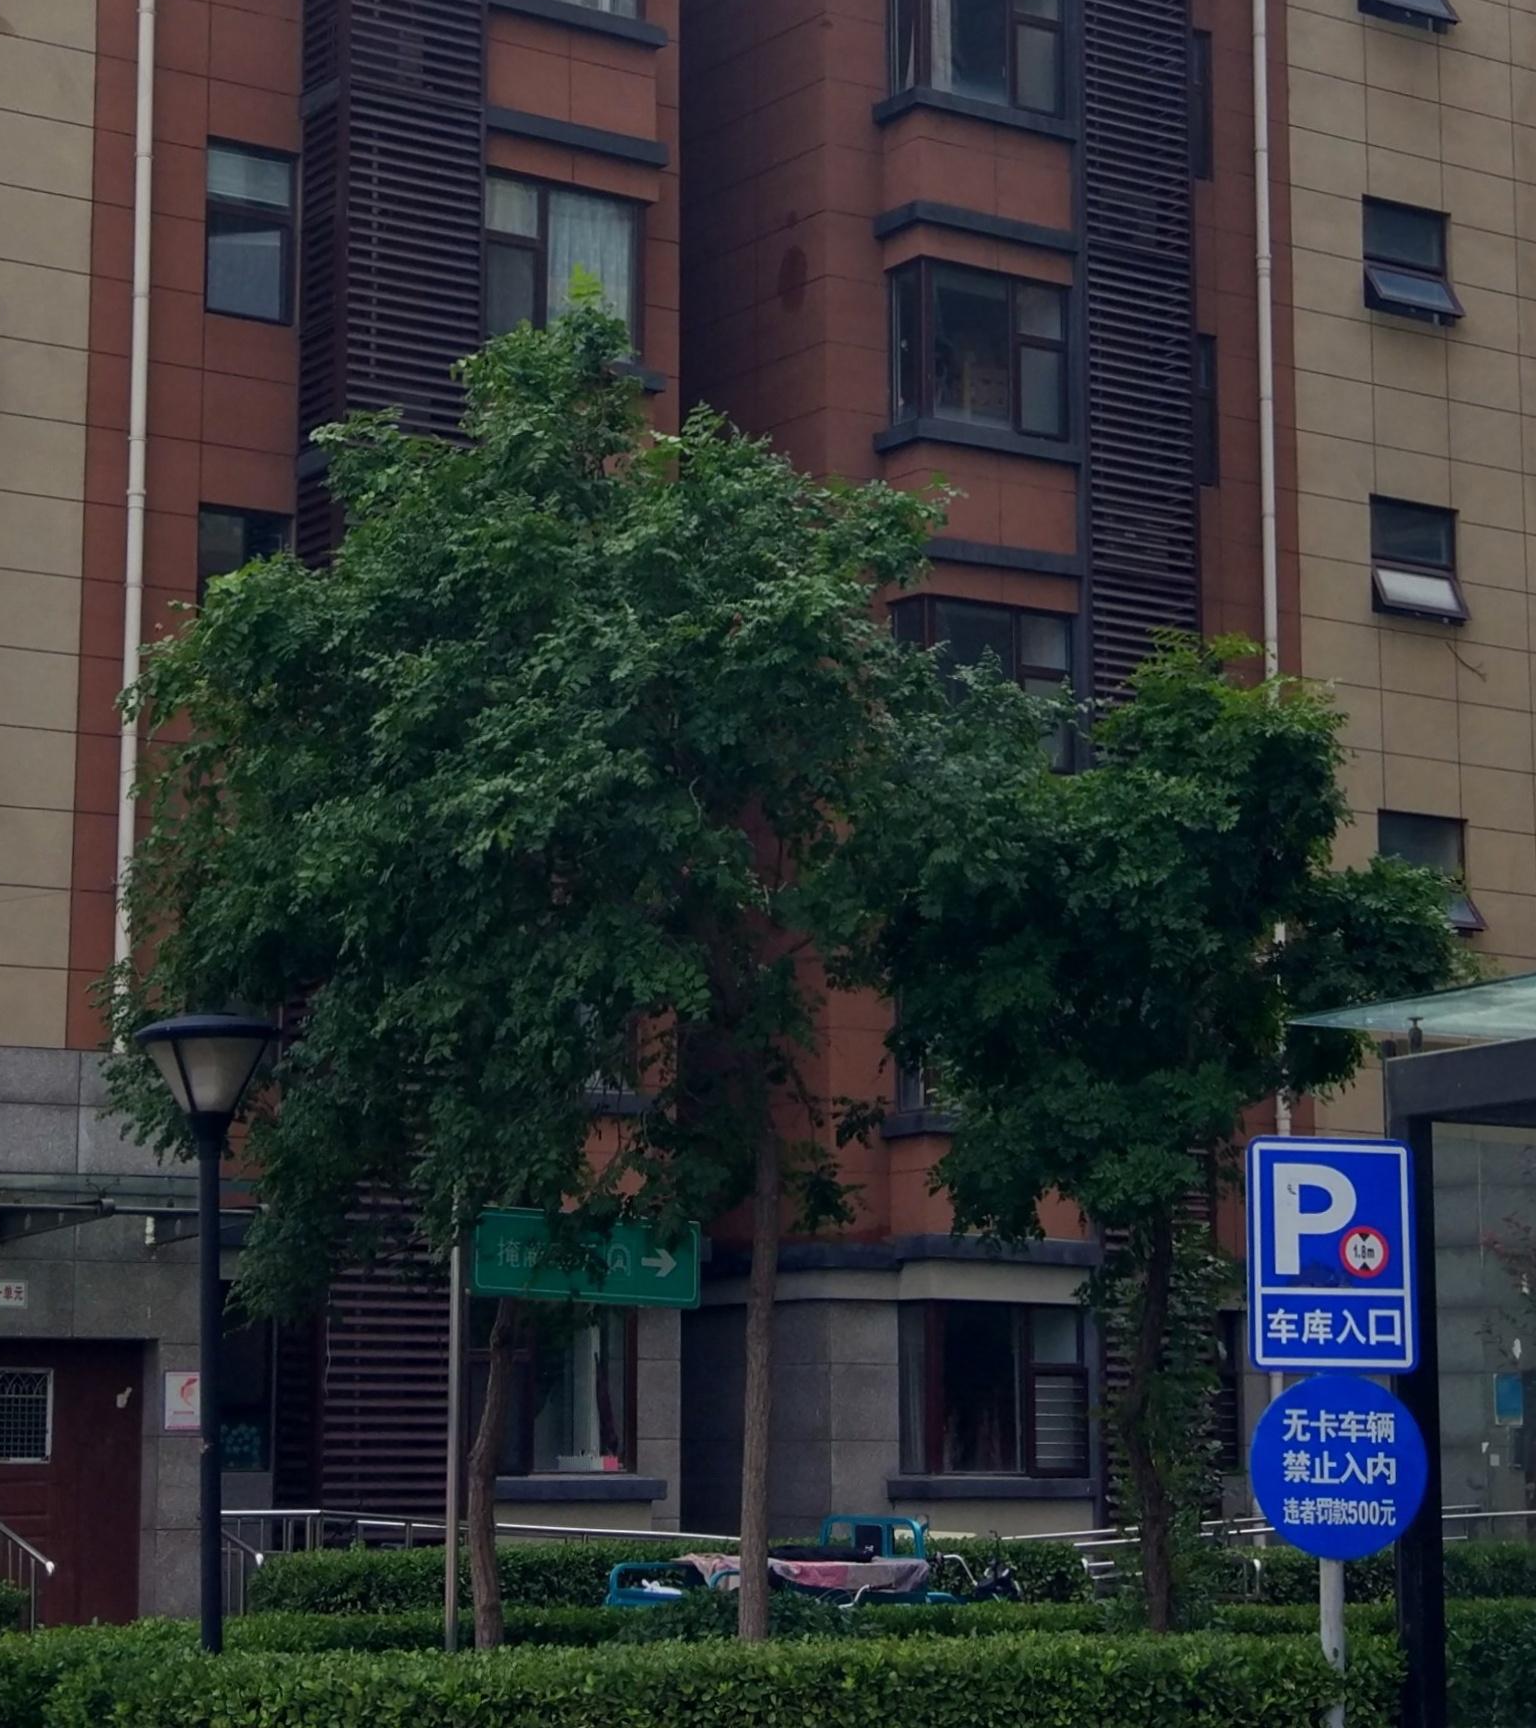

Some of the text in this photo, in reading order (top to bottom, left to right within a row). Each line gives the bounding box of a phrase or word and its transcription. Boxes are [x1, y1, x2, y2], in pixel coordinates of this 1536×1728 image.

[1273, 1162, 1357, 1275] P
[1353, 1244, 1375, 1259] 1.8m
[1267, 1308, 1402, 1345] 车库入口
[1282, 1408, 1396, 1444] 无卡车辆
[1282, 1450, 1397, 1485] 禁止入内
[1282, 1497, 1397, 1527] 违者罚款500元
